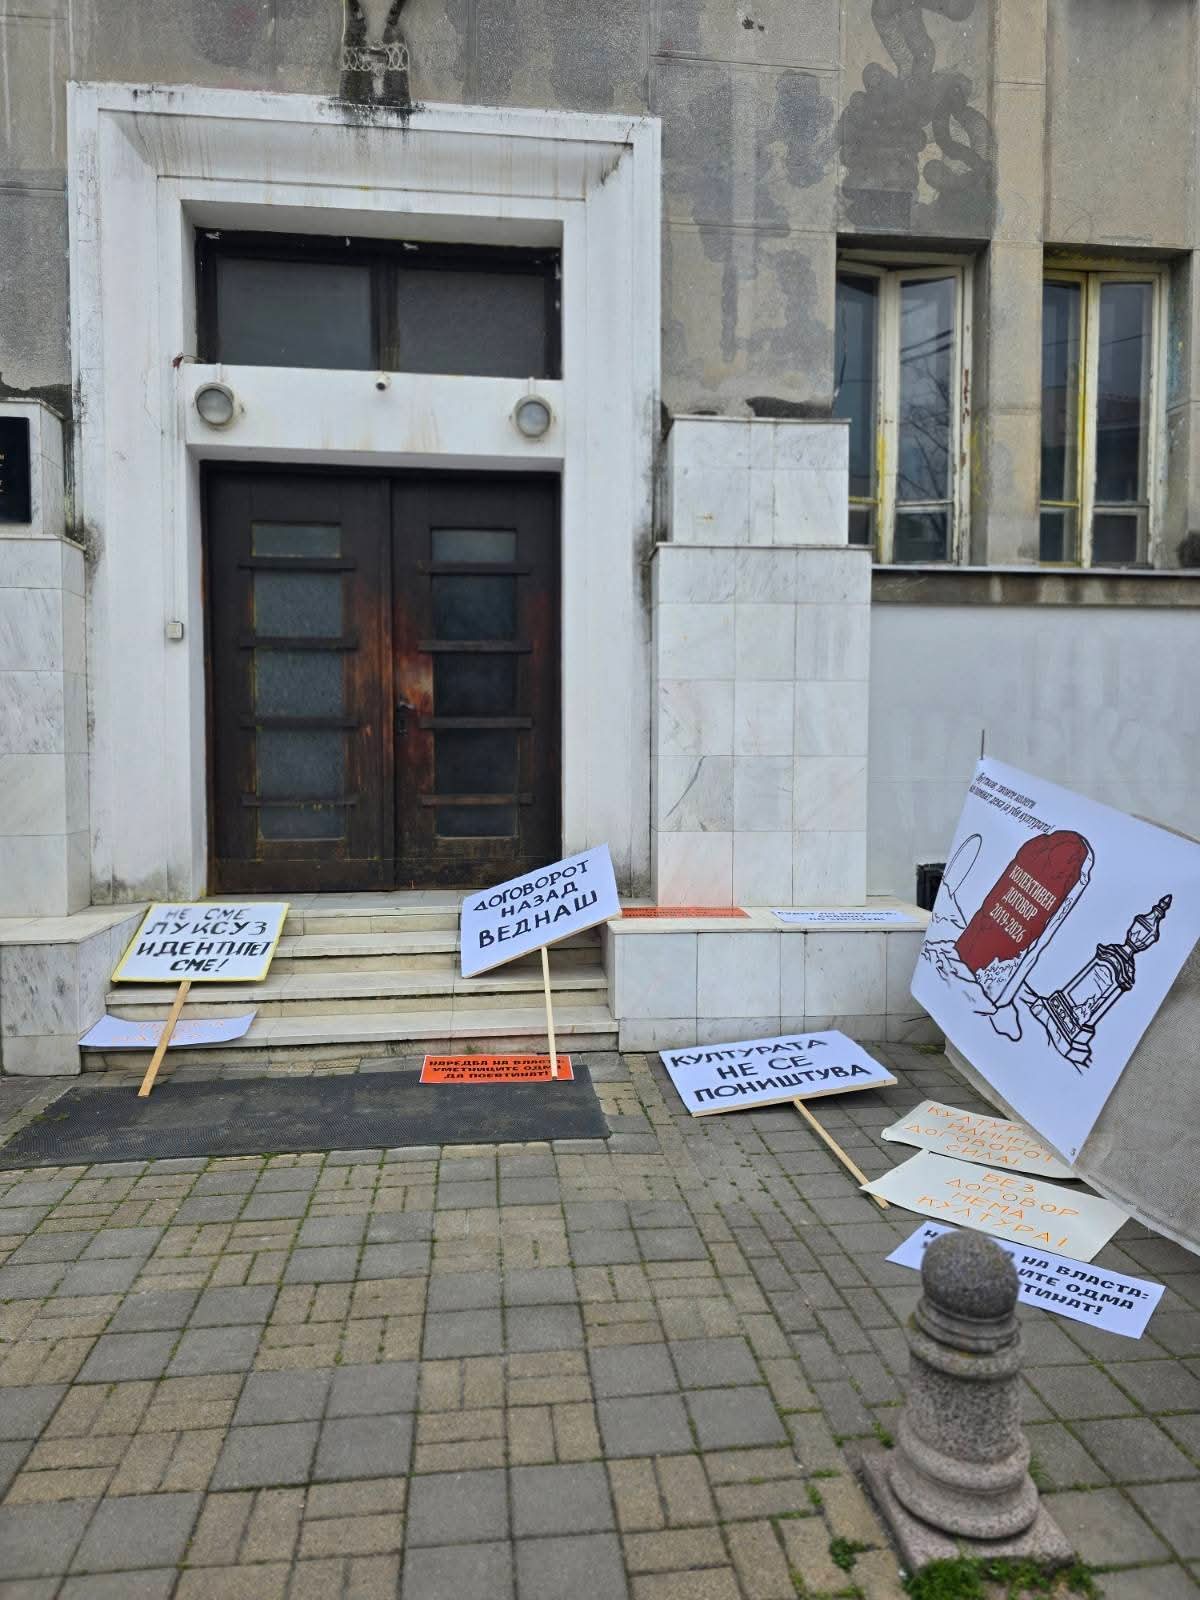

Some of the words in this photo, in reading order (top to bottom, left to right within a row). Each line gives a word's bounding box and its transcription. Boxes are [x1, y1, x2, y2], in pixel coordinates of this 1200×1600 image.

[473, 859, 590, 911] ДОГОВОРОТ
[501, 881, 578, 918] НАЗАД
[1008, 864, 1057, 911] КОЛЕКТИВЕН
[166, 907, 192, 920] НЕ
[204, 907, 249, 920] СМЕ
[479, 890, 598, 948] ВЕДНАШ
[1002, 886, 1039, 921] ДОГОВОР
[145, 921, 268, 935] ЛУКСУЗ
[989, 902, 1028, 944] 2019-2026
[136, 941, 274, 957] ИДЕНТИТЕТ
[170, 958, 230, 972] СМЕ!
[670, 1039, 829, 1067] КУЛТУРАТА
[716, 1063, 758, 1080] НЕ
[768, 1055, 814, 1070] СЕ
[694, 1064, 873, 1102] ПОНИШТУВА
[945, 1177, 1080, 1218] ДОГОВОР
[981, 1172, 1036, 1194] БЕЗ
[917, 1194, 1070, 1249] КУЛТУРА!
[951, 1191, 1026, 1221] НЕМА
[1021, 1255, 1050, 1271] НА
[1055, 1264, 1151, 1300] ВЛАСТА:
[1066, 1281, 1136, 1311] ОДМА
